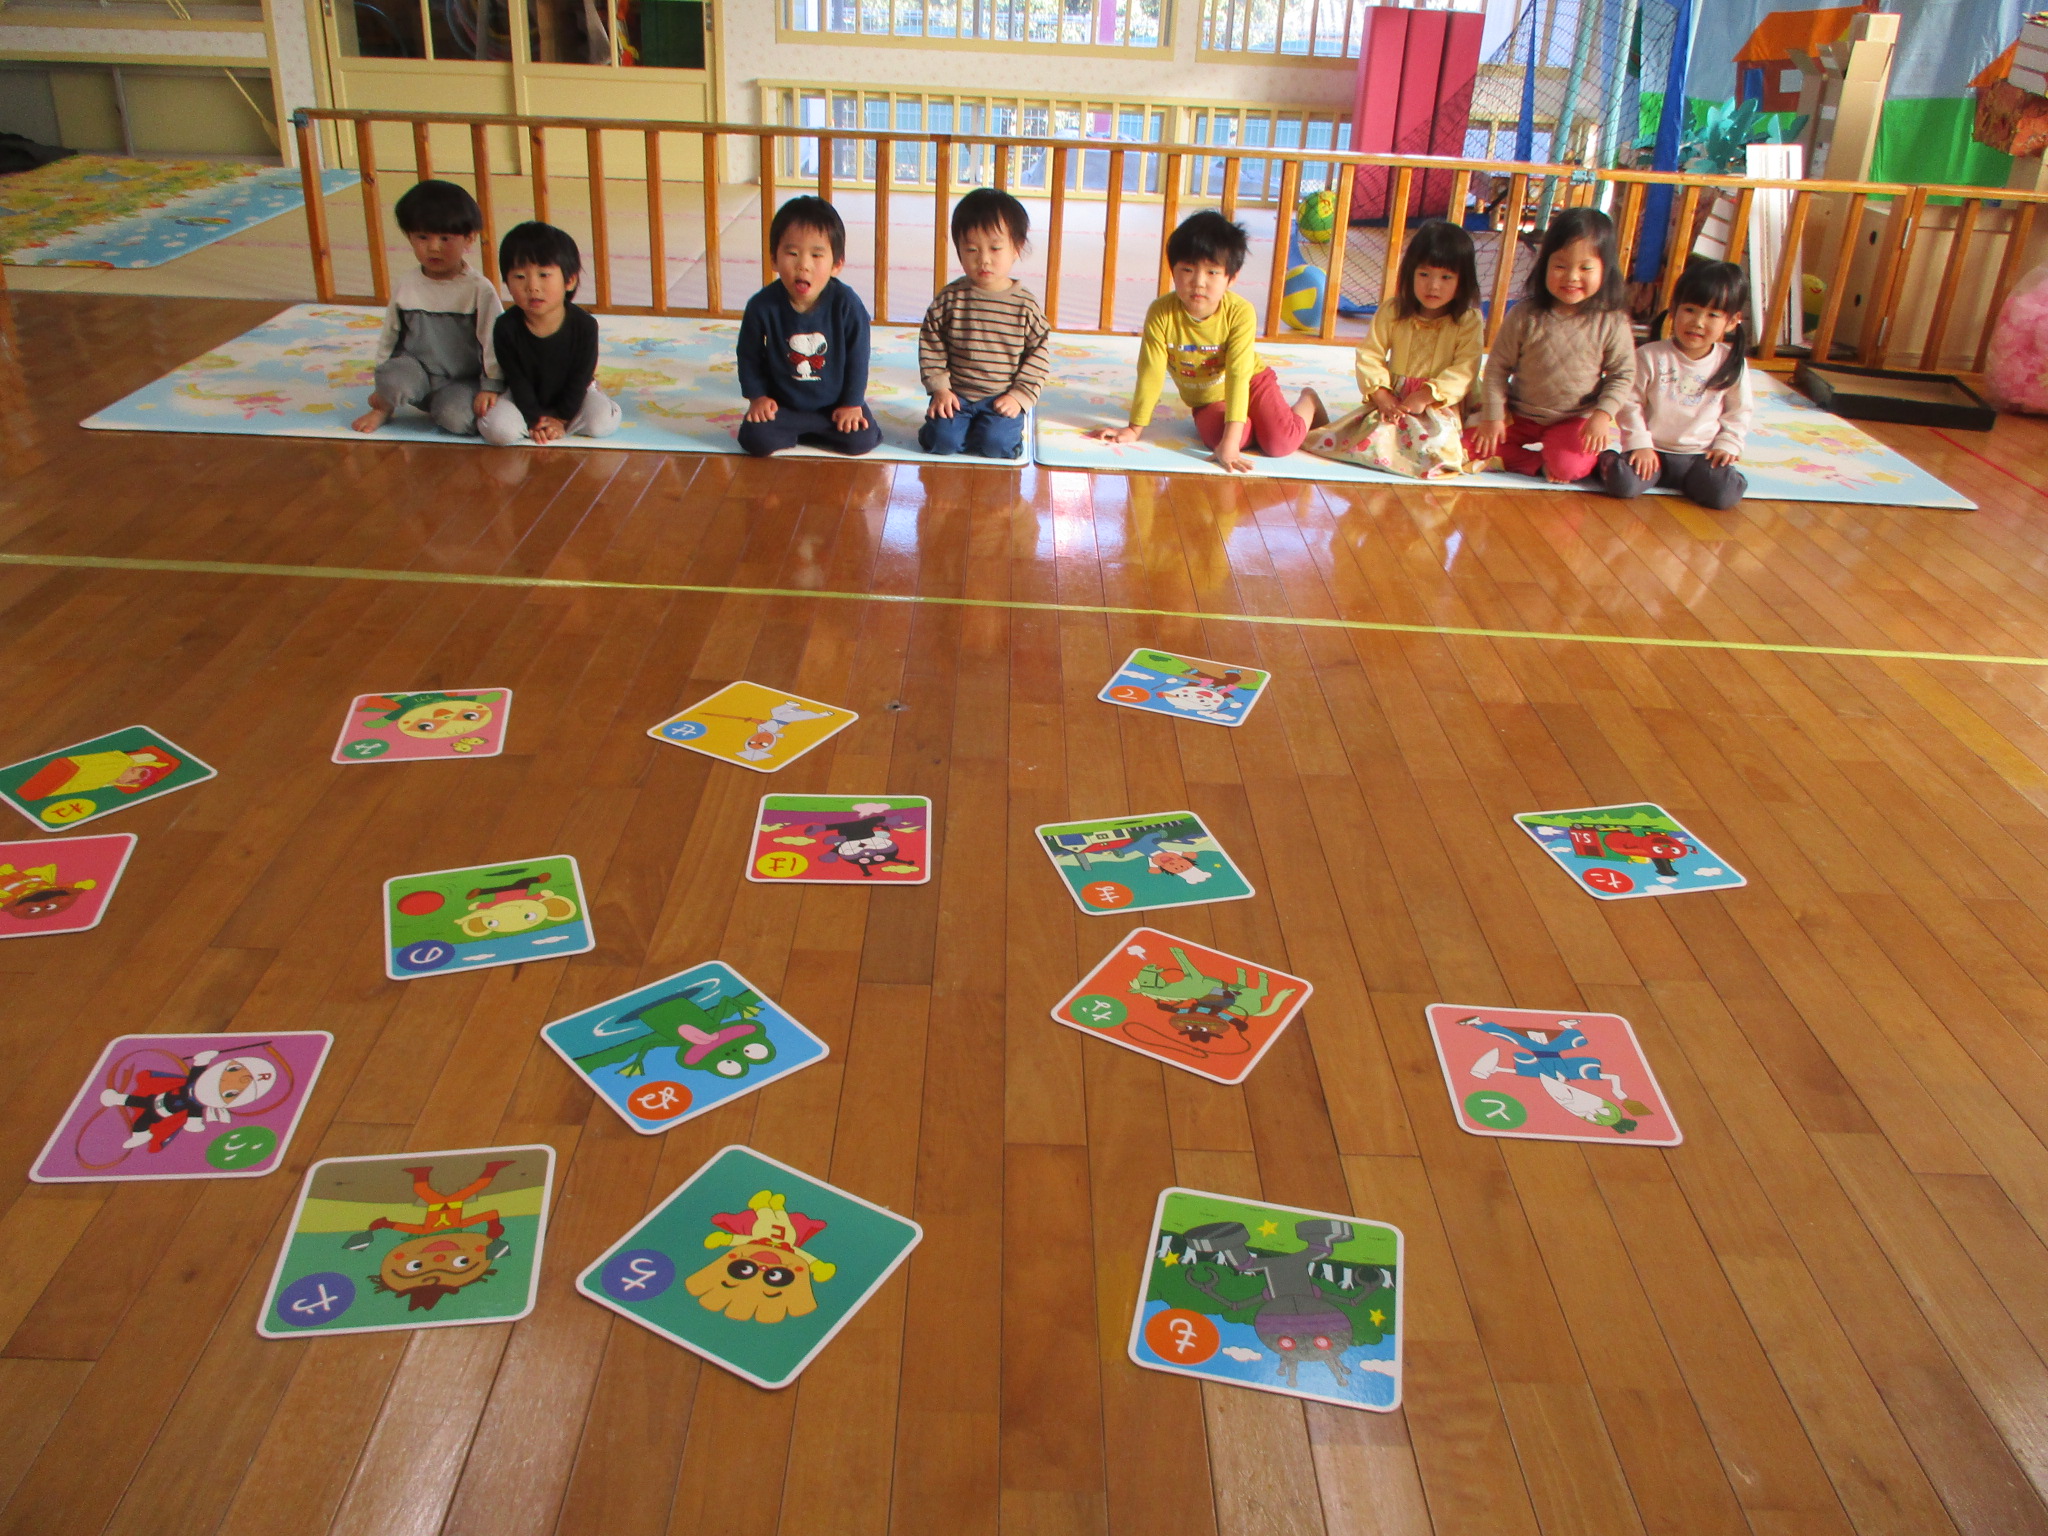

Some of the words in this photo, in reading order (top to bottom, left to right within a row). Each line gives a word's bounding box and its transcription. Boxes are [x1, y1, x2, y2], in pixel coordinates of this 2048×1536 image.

[1117, 688, 1138, 700] て
[671, 723, 697, 737] せ
[768, 857, 797, 872] は
[1590, 872, 1622, 889] た
[1095, 885, 1120, 903] ま
[409, 946, 444, 964] の
[1081, 1000, 1113, 1022] な
[256, 1072, 272, 1082] R
[636, 1086, 680, 1110] ぬ
[1480, 1098, 1511, 1121] と
[223, 1133, 264, 1161] ふ
[621, 1257, 657, 1292] ち
[291, 1283, 339, 1315] や
[1169, 1317, 1198, 1355] も
